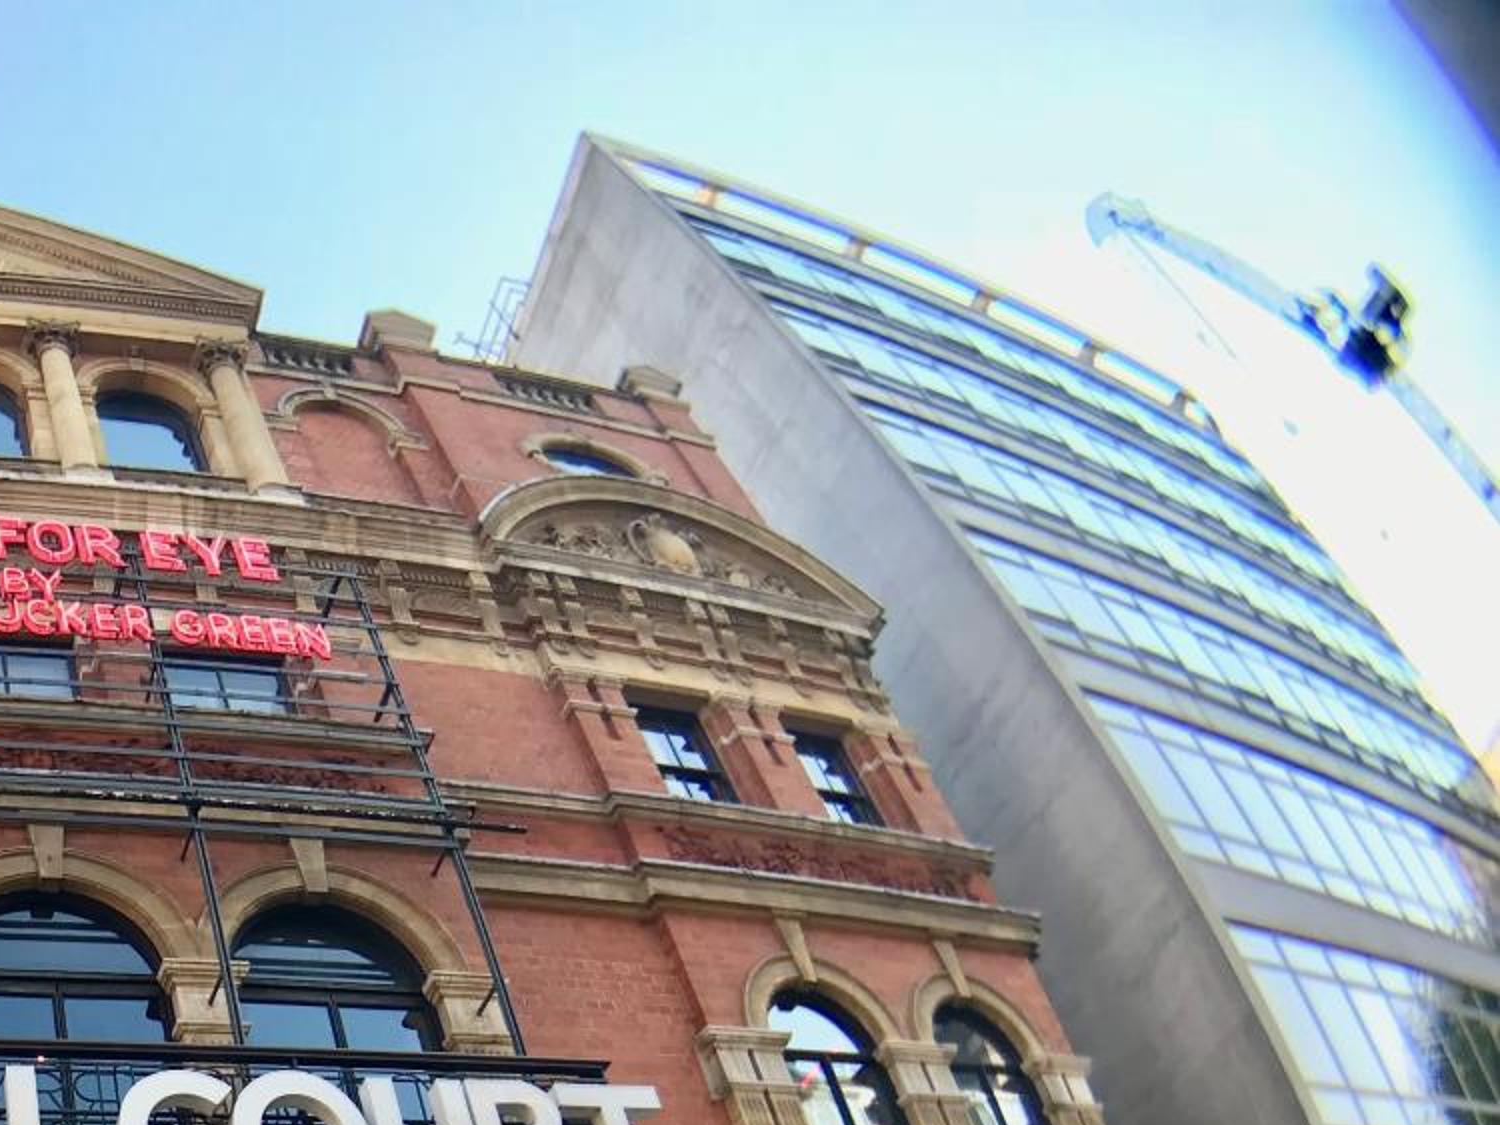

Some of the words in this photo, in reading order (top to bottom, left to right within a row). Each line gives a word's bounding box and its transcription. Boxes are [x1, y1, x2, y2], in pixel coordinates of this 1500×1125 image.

[139, 529, 280, 582] EYE
[0, 566, 63, 602] BY
[172, 608, 334, 661] GREEN
